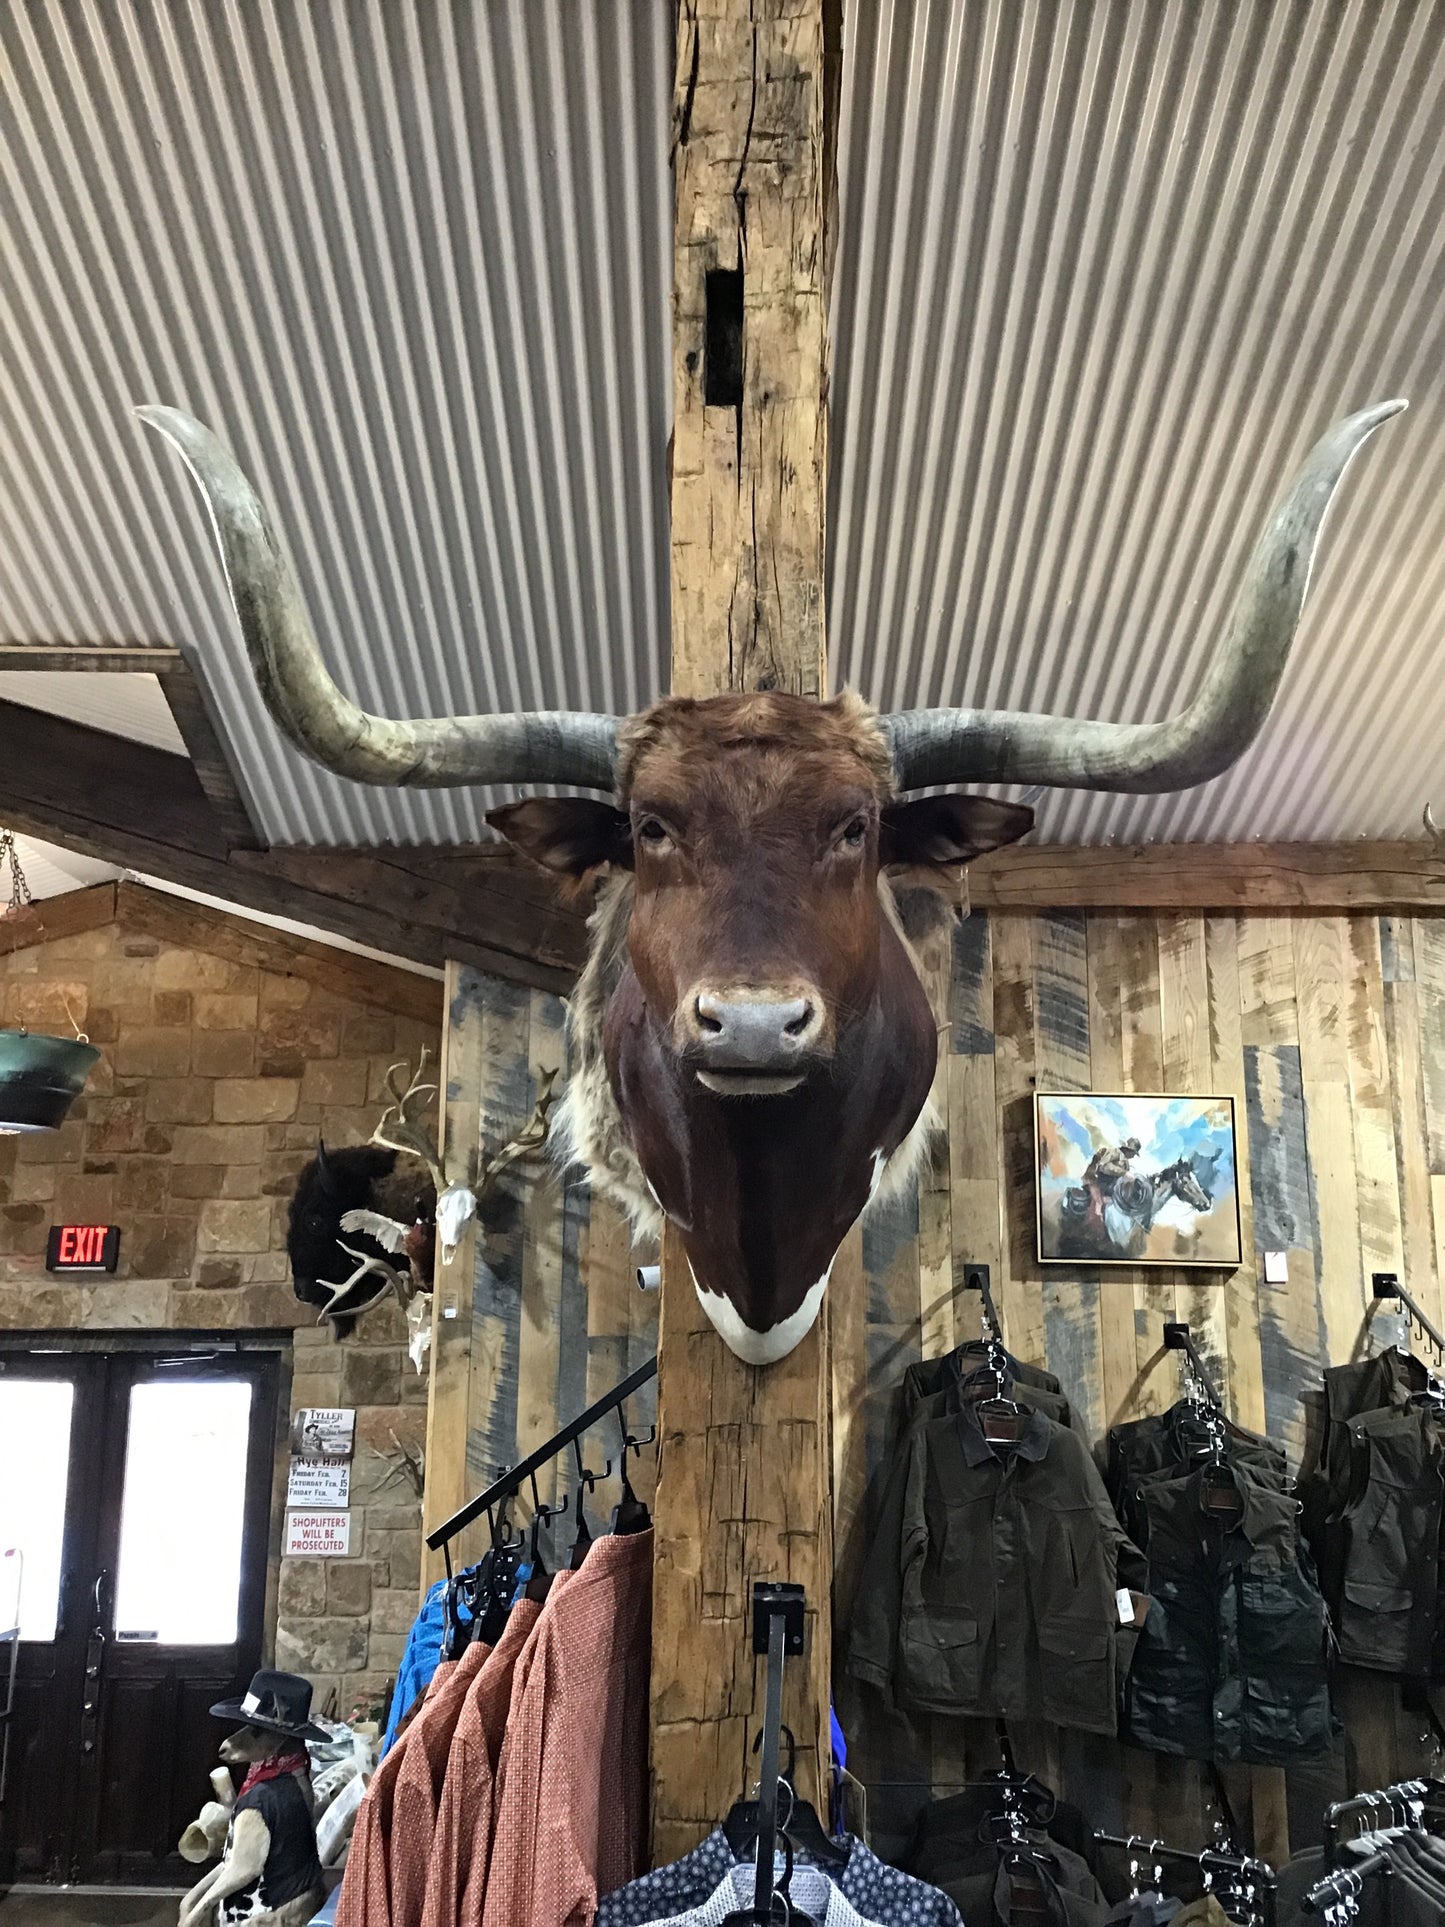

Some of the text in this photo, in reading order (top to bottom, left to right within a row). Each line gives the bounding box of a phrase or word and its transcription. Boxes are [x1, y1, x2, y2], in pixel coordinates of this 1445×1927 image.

[59, 1227, 108, 1262] EXIT
[297, 1457, 345, 1468] Hye Hall
[341, 1469, 347, 1478] 7
[340, 1479, 348, 1487] 15
[338, 1488, 347, 1497] 28
[292, 1517, 346, 1528] SHOPLIFTERS
[302, 1529, 335, 1539] WILL BE
[291, 1540, 345, 1550] PROSECUTED
